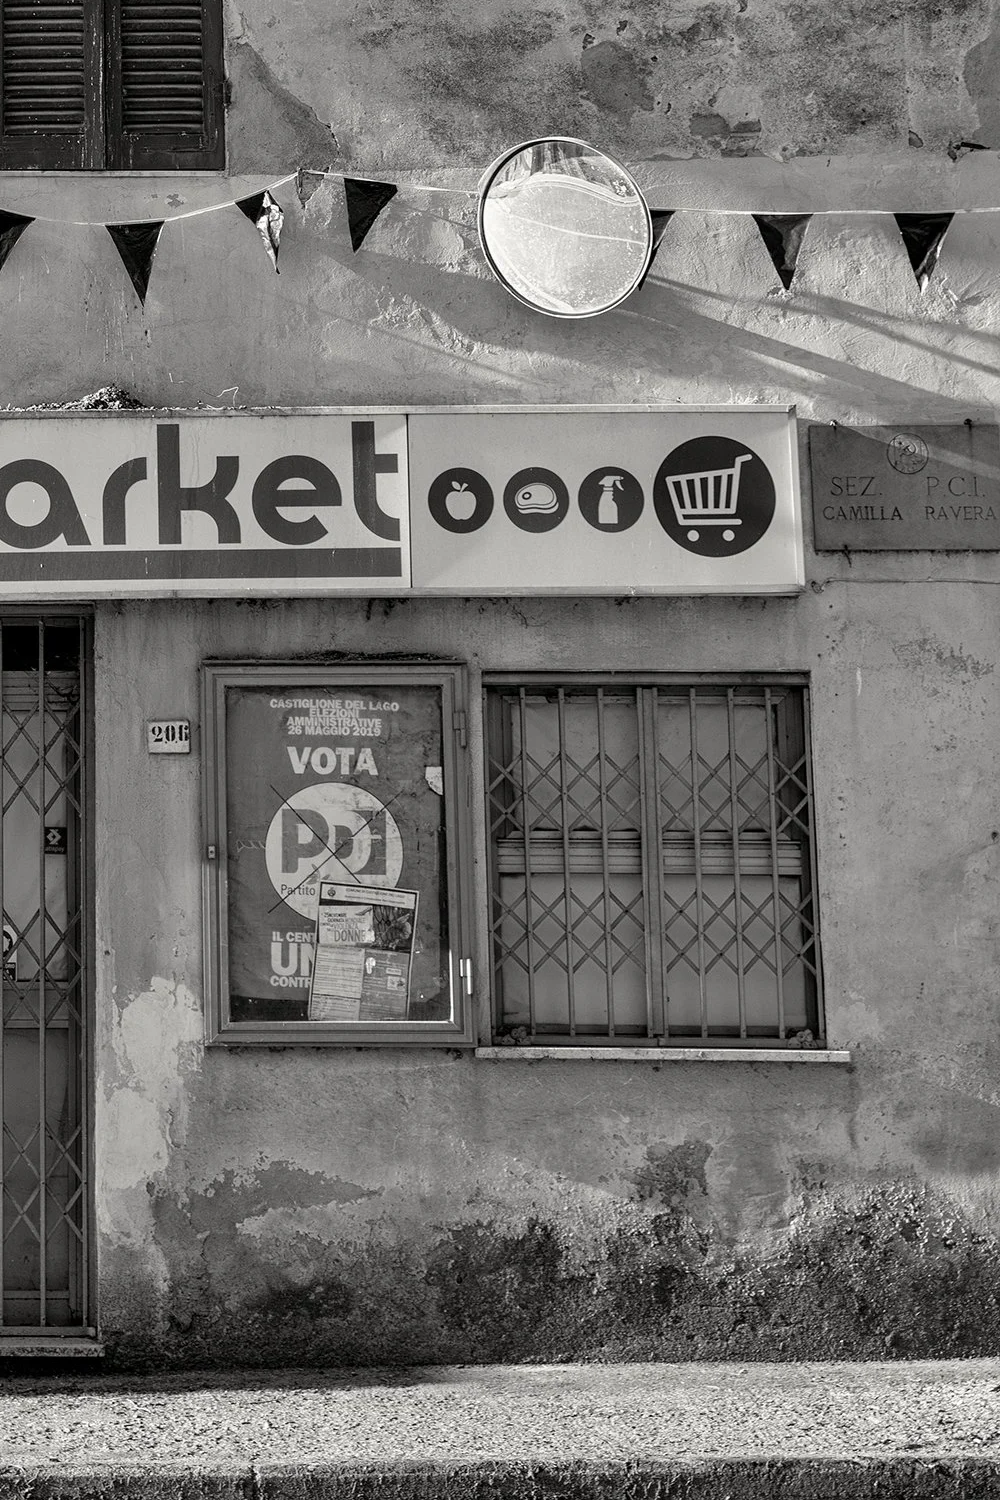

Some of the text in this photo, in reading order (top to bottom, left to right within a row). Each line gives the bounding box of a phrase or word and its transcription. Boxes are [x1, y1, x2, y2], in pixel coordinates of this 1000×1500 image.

[830, 476, 986, 497] SEZ. P.C.I.
[822, 505, 997, 521] CAMILLA RAVERA
[269, 698, 400, 712] CASTIGLIONE DEL LAGO
[309, 708, 359, 718] ELEZIONI
[286, 716, 382, 728] AMMINISTRATIVE
[287, 726, 381, 737] 26 MAGGIO 2019
[286, 746, 379, 775] VOTA
[280, 884, 316, 896] Partito
[272, 931, 284, 941] IL
